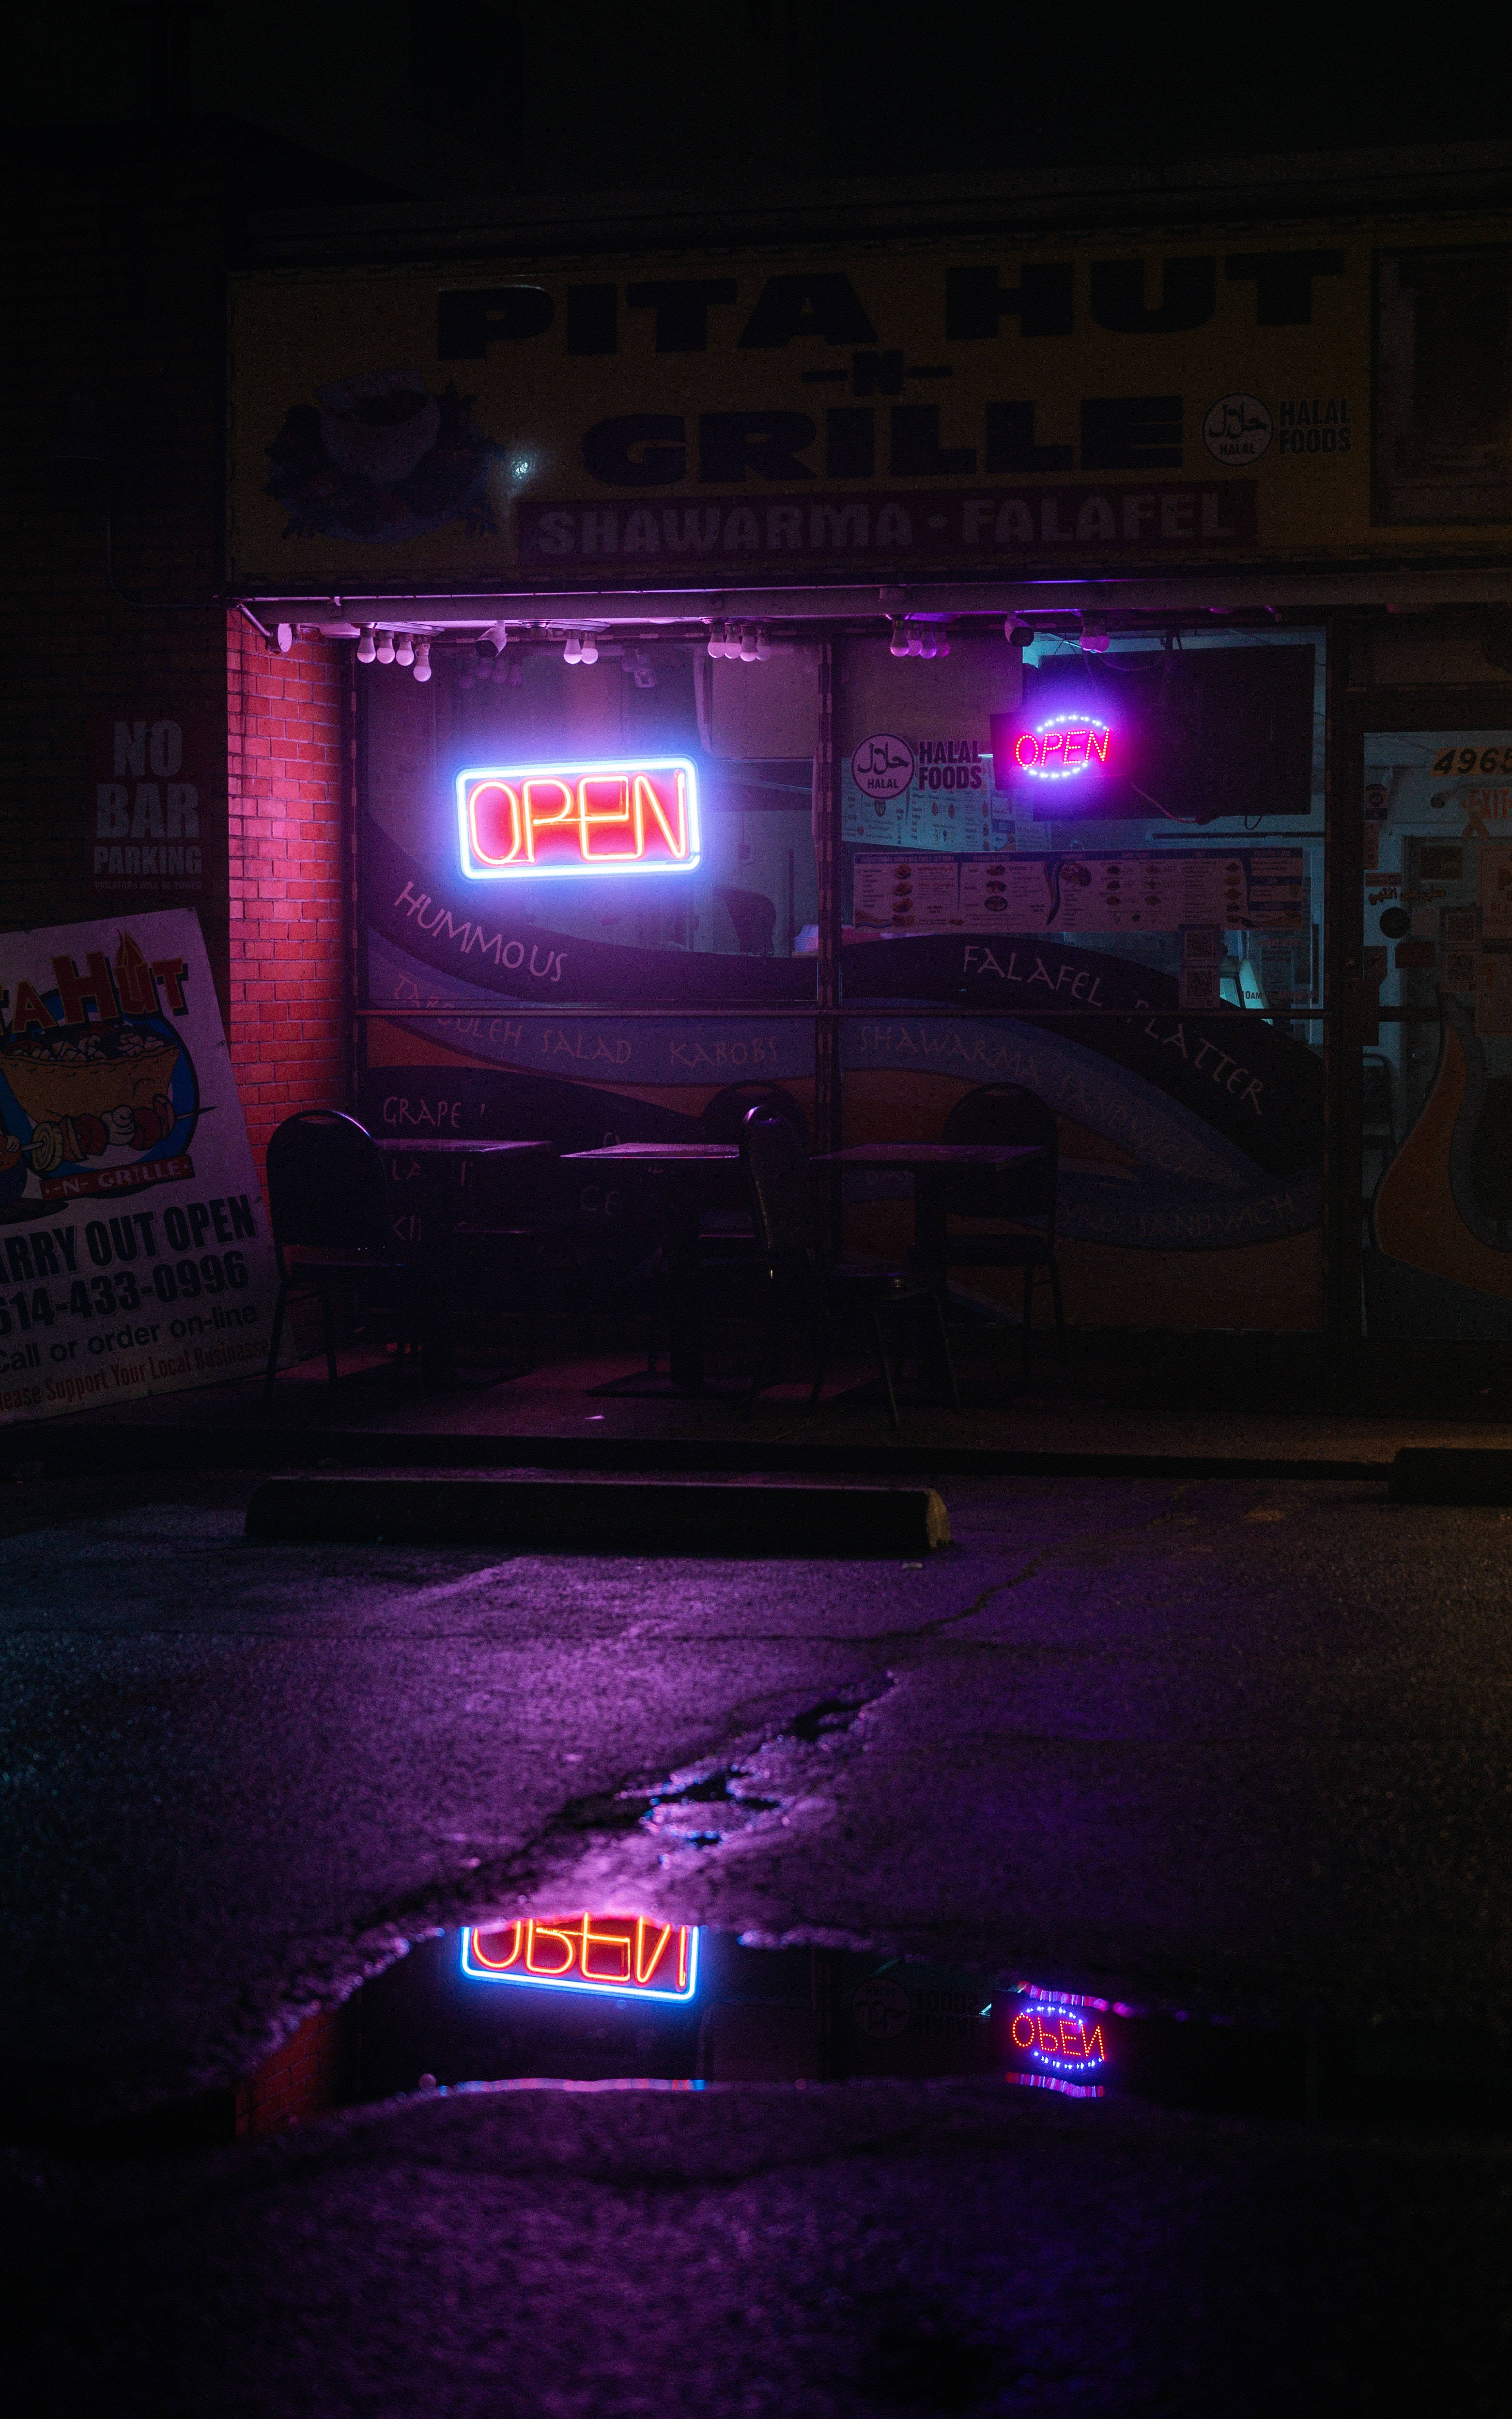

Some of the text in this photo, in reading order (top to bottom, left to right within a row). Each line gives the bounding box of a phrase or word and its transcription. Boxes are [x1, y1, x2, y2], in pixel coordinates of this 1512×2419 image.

[437, 249, 1345, 360] PITA HUT
[1279, 398, 1351, 426] HALAL
[581, 395, 1184, 485] GRILLE
[1220, 443, 1255, 456] HALAL
[1279, 427, 1351, 455] FOODS
[537, 492, 1235, 556] SHAWARMA FALAFEL
[113, 720, 182, 777] NO
[919, 740, 983, 764] HALAL
[1016, 729, 1110, 767] OPEN
[1433, 748, 1512, 774] 4965
[867, 778, 899, 789] HALAL
[918, 765, 983, 790] FOODS
[96, 783, 199, 838] BAR
[468, 771, 688, 866] OPEN
[94, 846, 202, 875] PARKING
[174, 881, 202, 890] TOWED
[394, 880, 568, 982] HUMMOUS
[50, 949, 185, 1026] HUT
[963, 944, 1103, 1007] FALAFEL
[540, 1029, 631, 1063] SALAD
[670, 1034, 778, 1067] KABOBS
[383, 1096, 462, 1128] GRAPE
[859, 1025, 1203, 1183] SHAWARMA SANDWICH
[97, 1159, 181, 1187] GRILLE
[85, 1211, 157, 1267] OUT
[163, 1194, 256, 1252] OPEN
[1056, 1191, 1295, 1238] YRO SANDWICH
[50, 1340, 78, 1362] or
[88, 1322, 160, 1355] order
[170, 1304, 258, 1339] on-line
[45, 1369, 109, 1403] Support
[110, 1362, 145, 1387] Your
[150, 1349, 192, 1380] Local
[193, 1339, 271, 1371] Businesse
